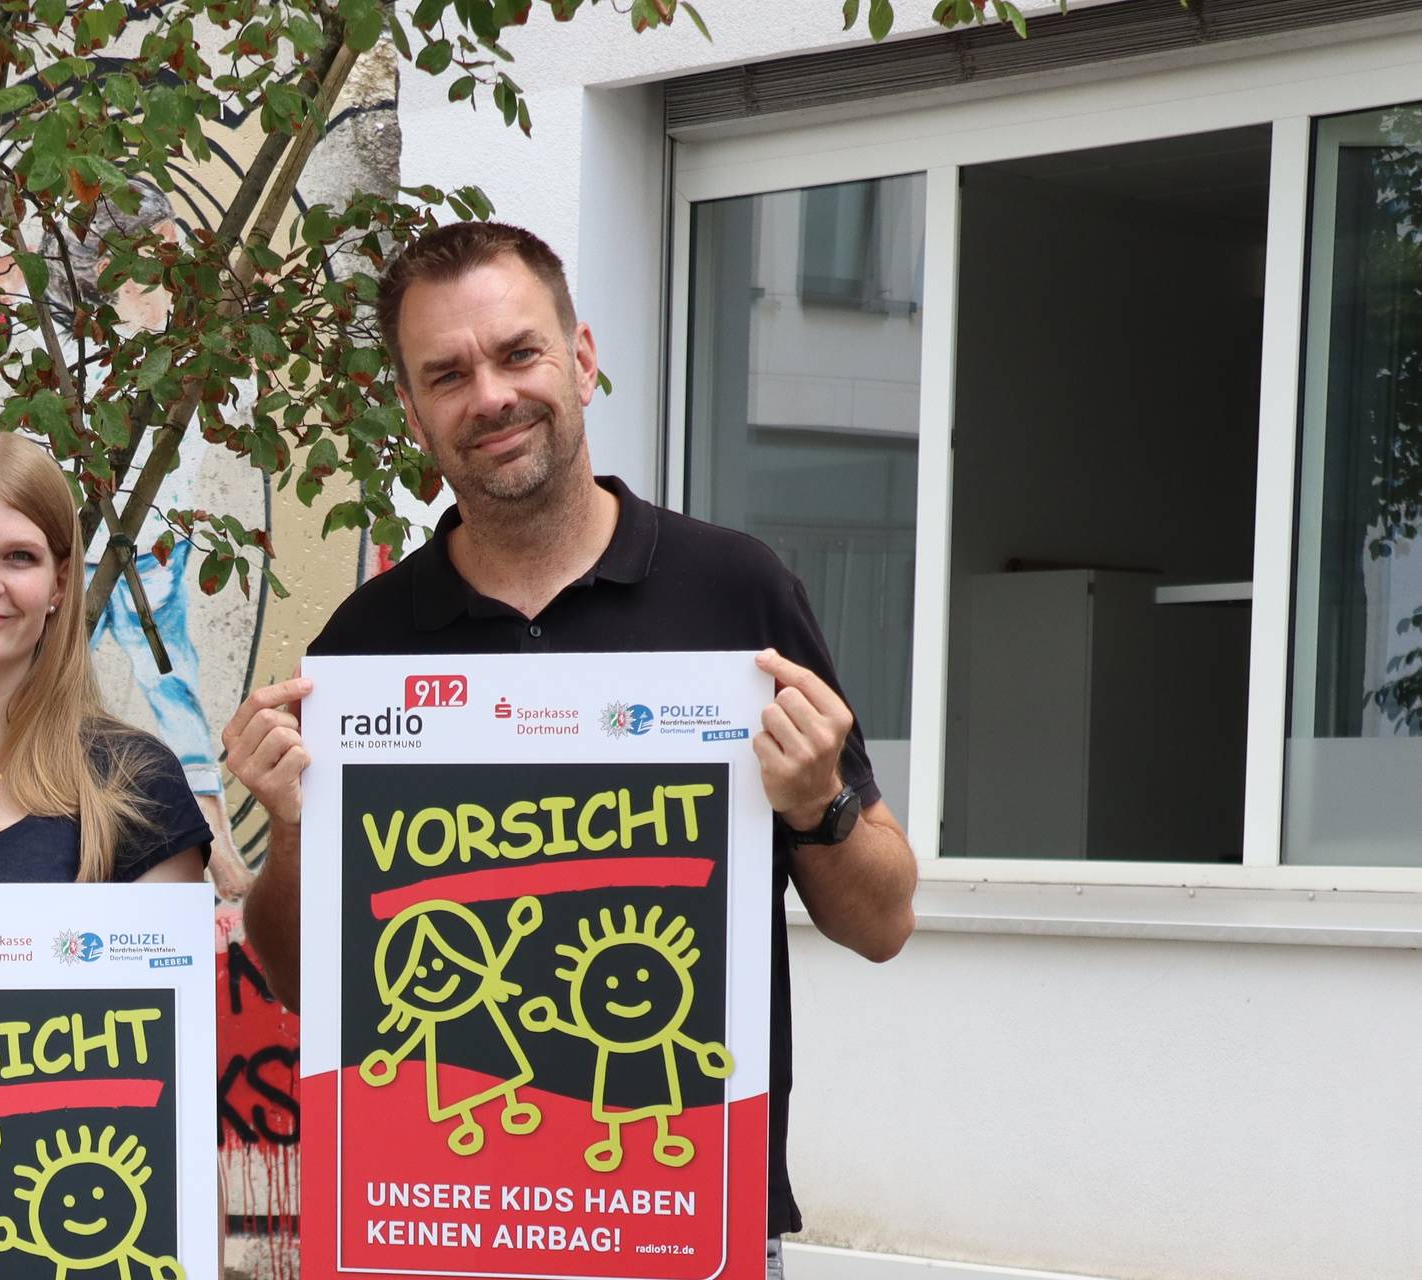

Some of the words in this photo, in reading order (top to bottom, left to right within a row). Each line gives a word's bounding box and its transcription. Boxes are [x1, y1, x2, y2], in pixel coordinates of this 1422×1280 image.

[341, 707, 423, 736] radio
[414, 680, 464, 706] 91.2
[516, 707, 579, 721] Sparkasse
[660, 705, 719, 717] POLIZEI
[516, 723, 579, 735] Dortmund
[706, 730, 744, 740] #LEBEN
[341, 740, 365, 749] MEIN
[368, 740, 422, 749] DORTMUND
[362, 783, 714, 872] VORSICHT
[109, 933, 165, 945] POLIZEI
[153, 957, 188, 967] #LEBEN
[367, 1182, 491, 1210] UNSERE
[501, 1186, 574, 1212] KIDS
[585, 1188, 696, 1216] HABEN
[367, 1220, 481, 1248] KEINEN
[492, 1224, 621, 1252] AIRBAG!
[635, 1244, 695, 1255] radio912.de
